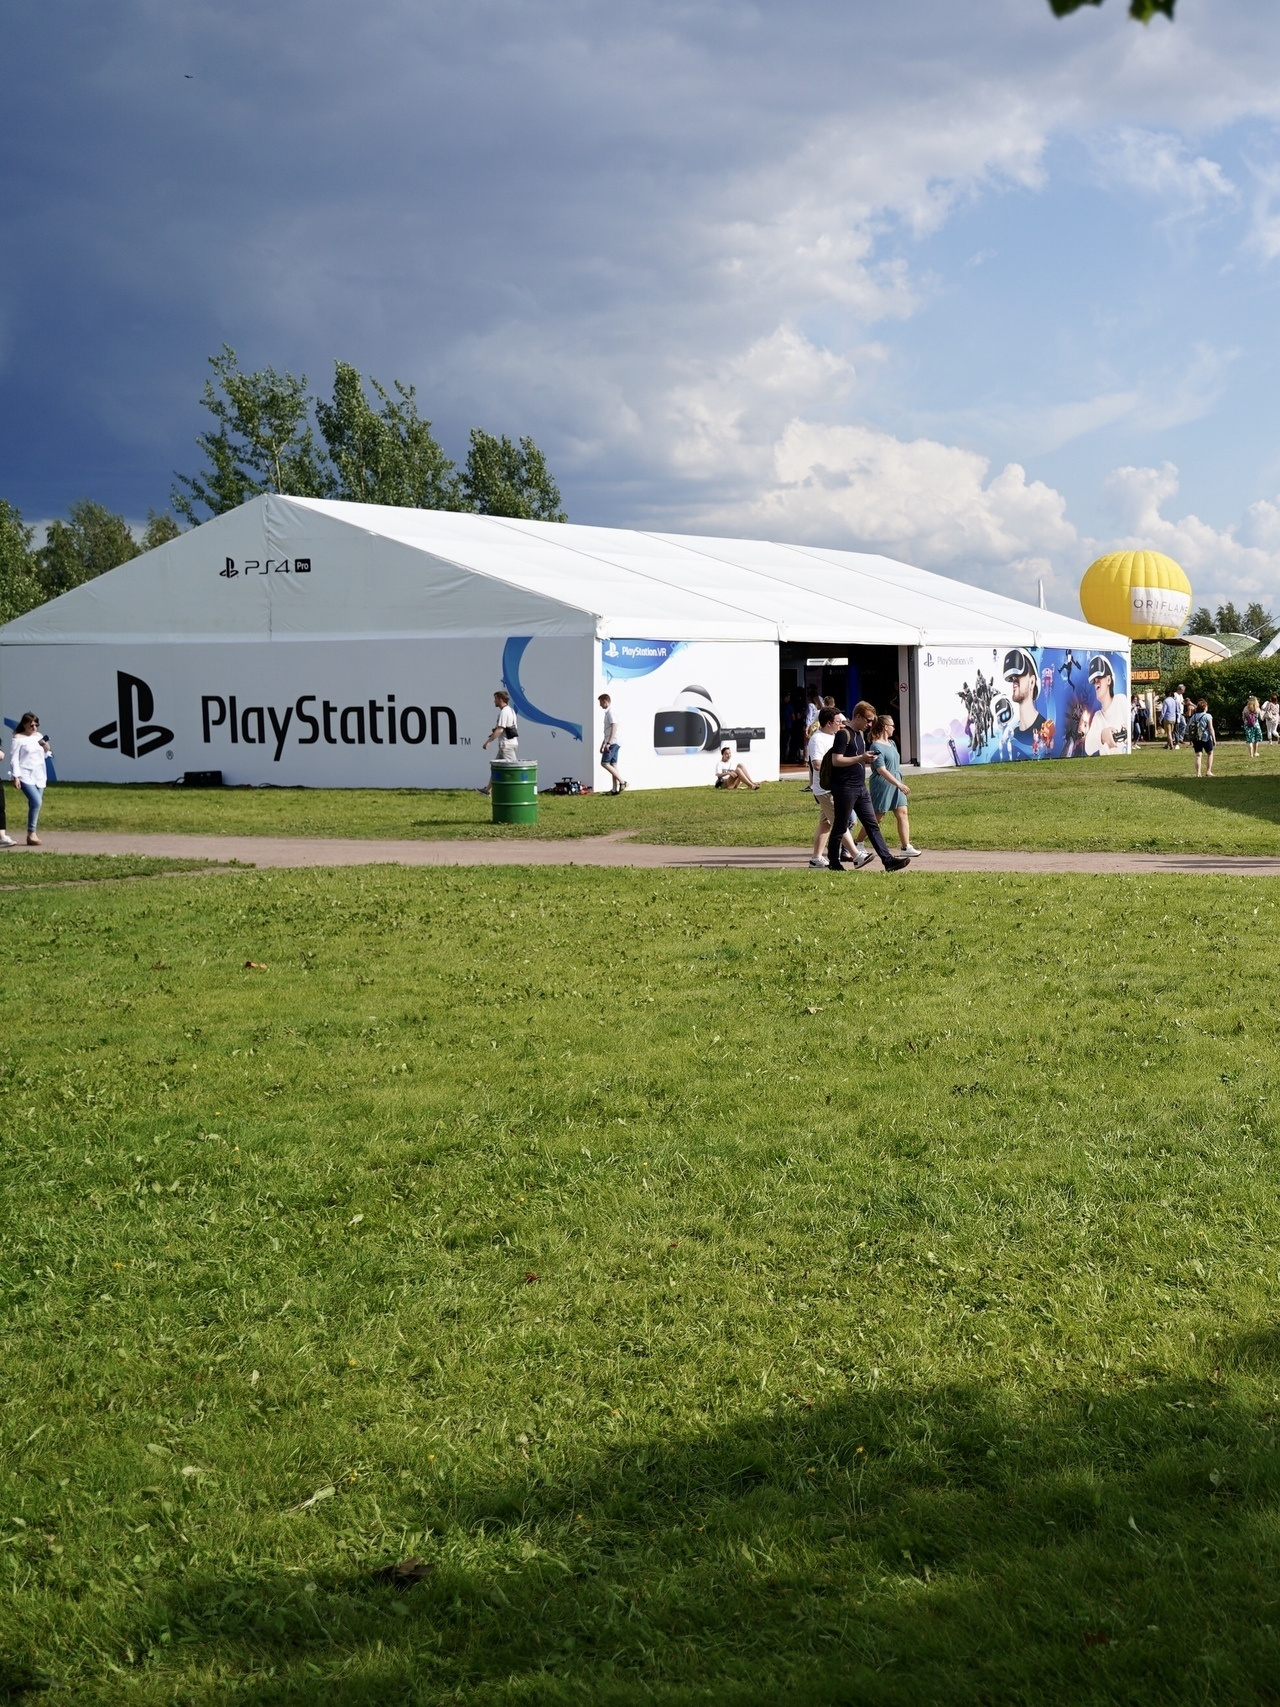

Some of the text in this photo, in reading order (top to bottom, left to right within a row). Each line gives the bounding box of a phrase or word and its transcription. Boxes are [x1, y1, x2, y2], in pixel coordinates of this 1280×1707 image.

[245, 559, 290, 575] PS4
[1133, 599, 1188, 613] ORIFLAME
[201, 694, 458, 762] PlayStation
